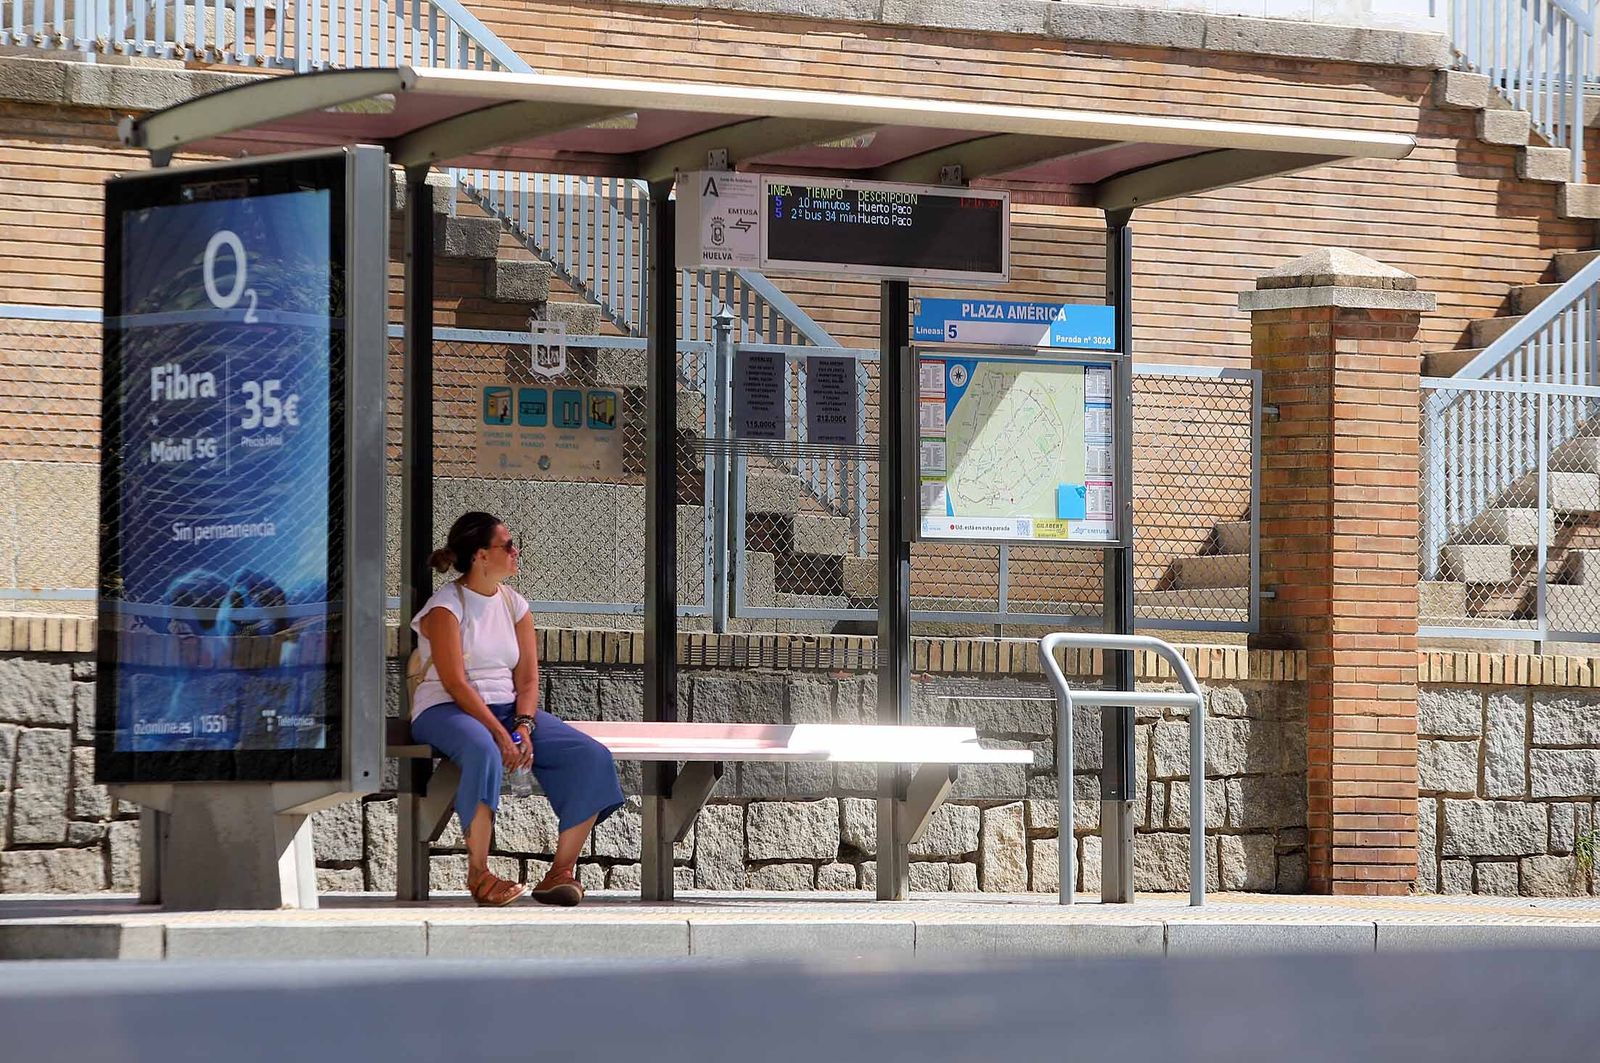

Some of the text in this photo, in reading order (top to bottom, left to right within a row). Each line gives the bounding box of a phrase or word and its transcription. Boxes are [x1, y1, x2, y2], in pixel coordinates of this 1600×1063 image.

[775, 196, 913, 215] 5 10 minutos Huerto Paco
[806, 187, 844, 200] TIEMPO
[858, 190, 918, 205] DESCRIPCION
[728, 208, 758, 216] EMTUSA
[775, 207, 782, 218] 5
[804, 209, 822, 221] bus
[825, 211, 836, 222] 34
[840, 212, 857, 223] min
[858, 213, 890, 225] Huerto
[892, 214, 913, 227] Paco
[702, 251, 733, 260] HUELVA
[962, 302, 1066, 322] PLAZA AMÉRICA
[948, 324, 958, 339] 5
[1055, 335, 1082, 344] Parada
[1093, 336, 1112, 345] 3024
[150, 362, 217, 401] Fibra
[241, 379, 299, 430] 35€
[151, 437, 218, 463] Móvil 5G
[172, 517, 277, 546] Sin permanencia
[133, 715, 228, 735] o2online.es 1551
